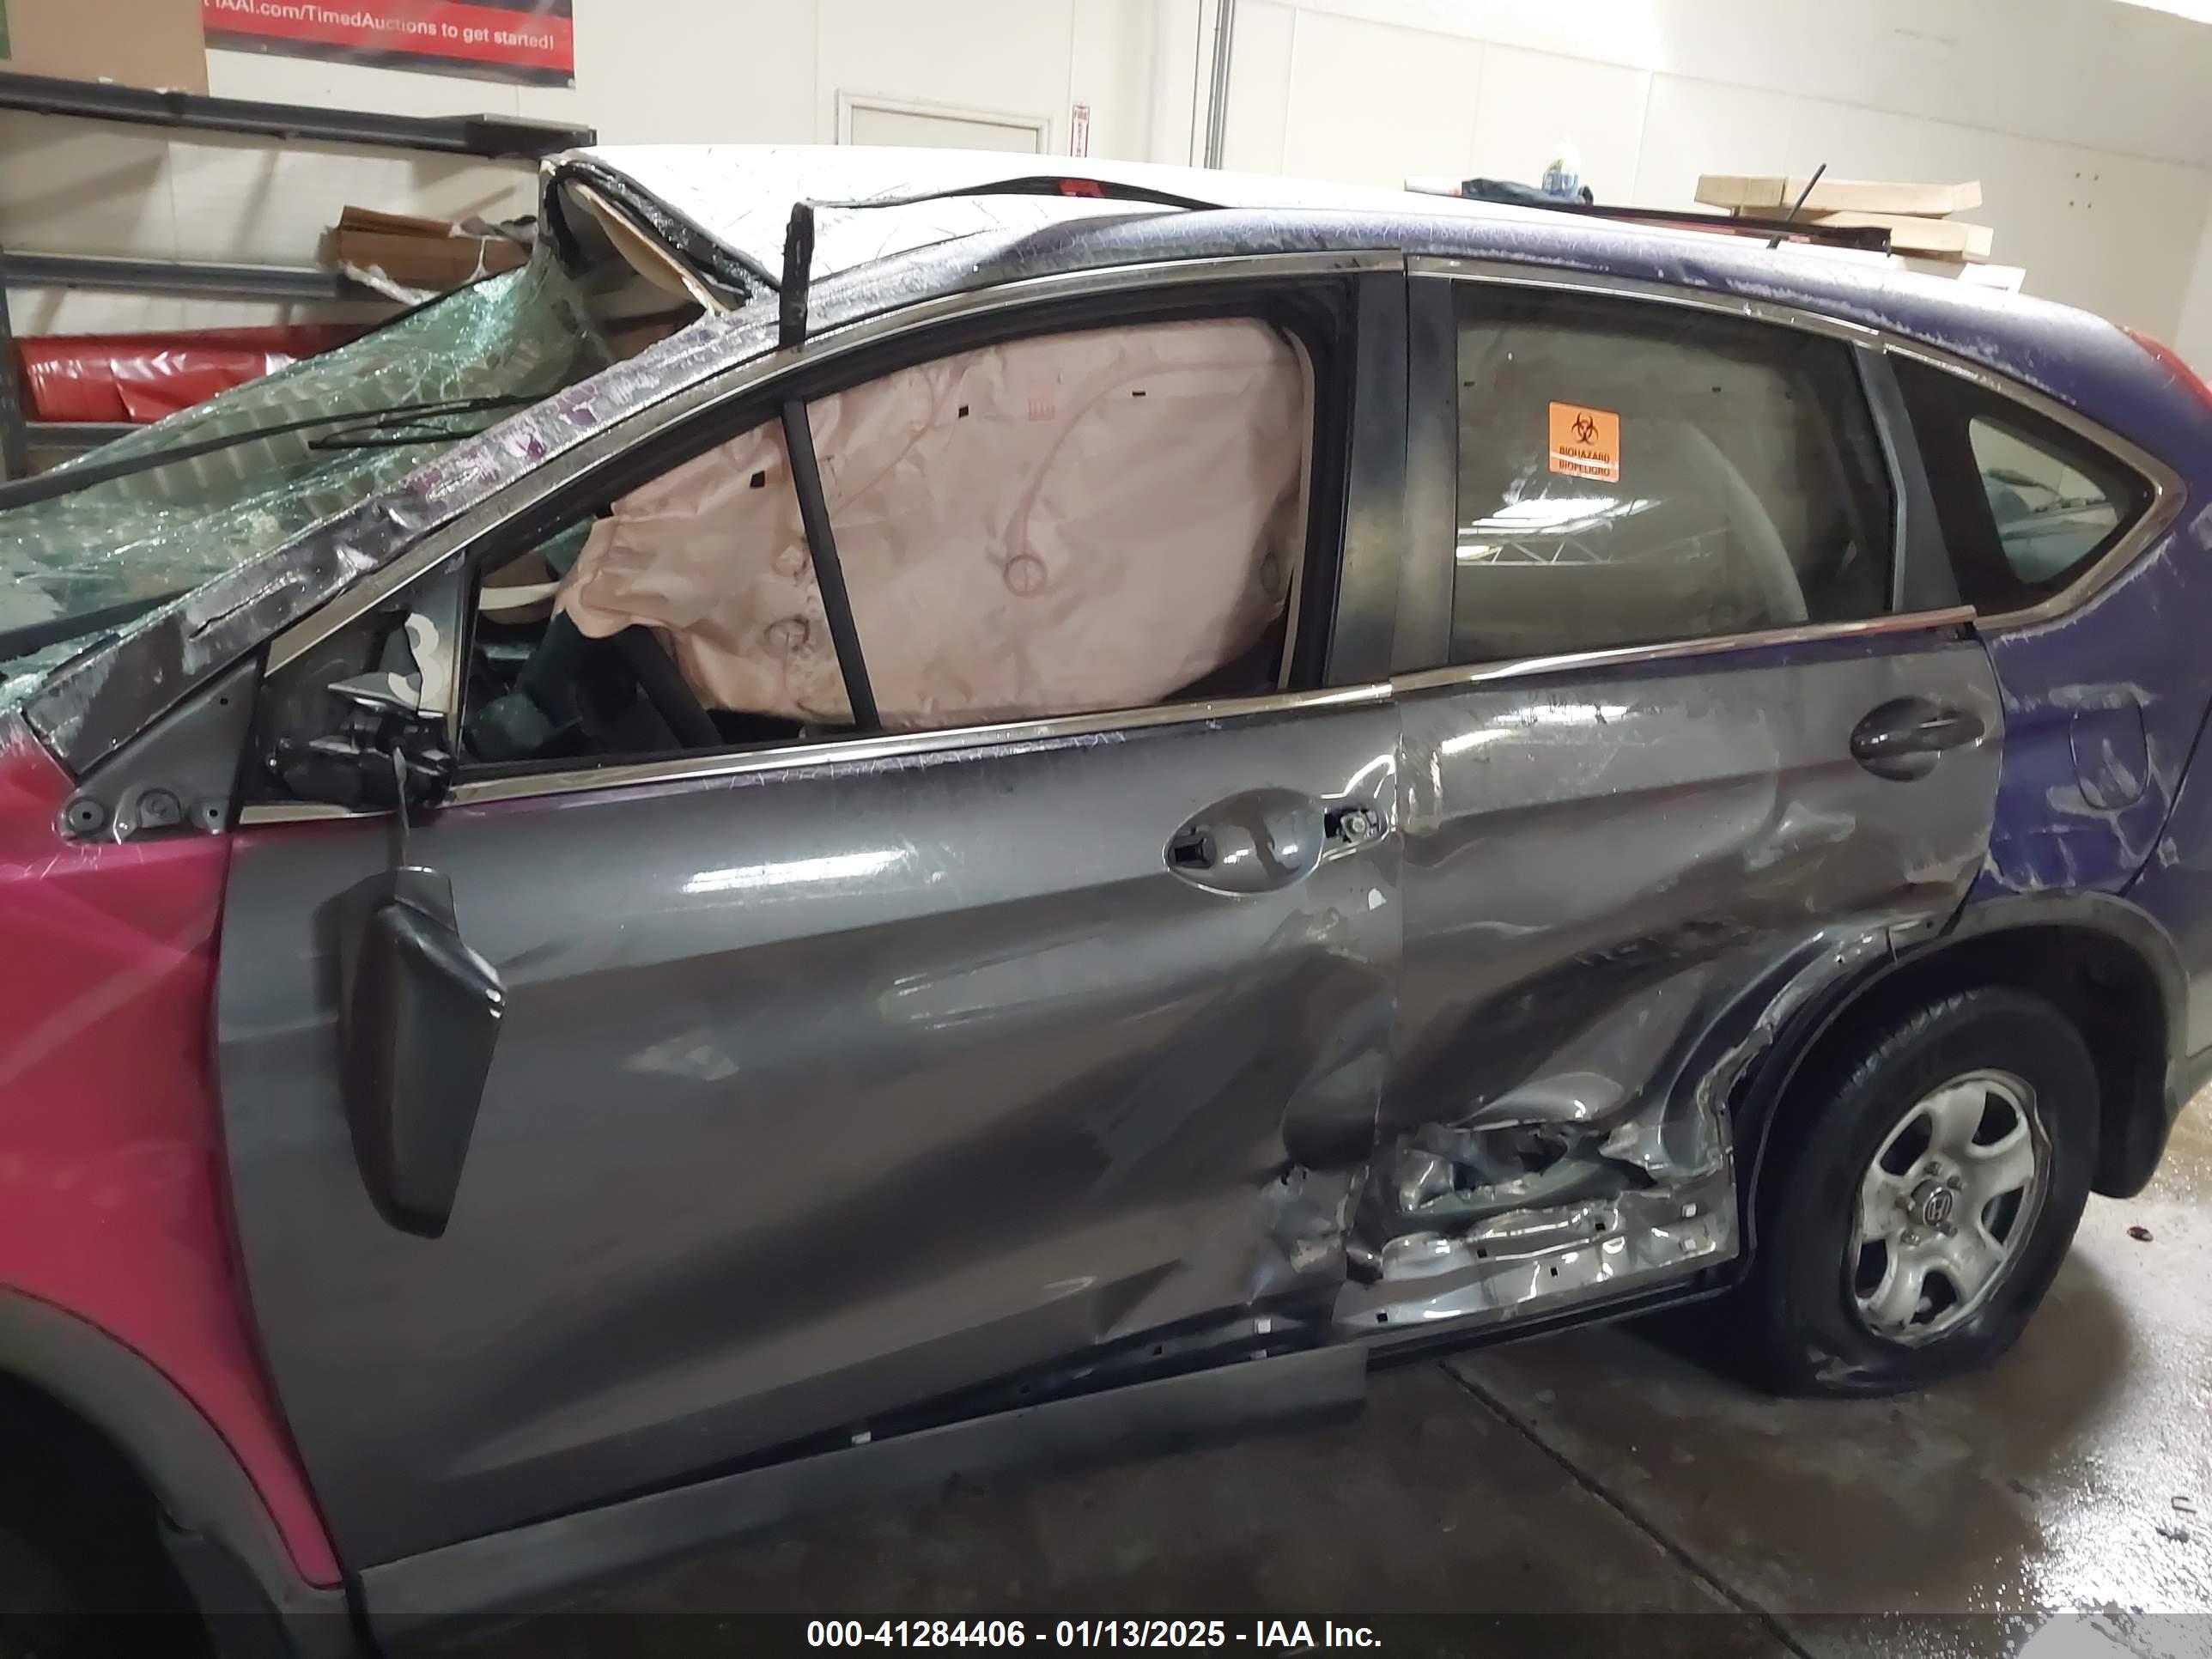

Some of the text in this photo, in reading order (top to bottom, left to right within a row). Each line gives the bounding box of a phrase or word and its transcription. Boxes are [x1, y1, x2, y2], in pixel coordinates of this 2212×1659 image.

[441, 22, 458, 39] to
[463, 27, 489, 44] get
[493, 32, 555, 50] started!
[1559, 446, 1610, 465] BIOHAZARD
[1559, 459, 1611, 477] BIOPELIGRO
